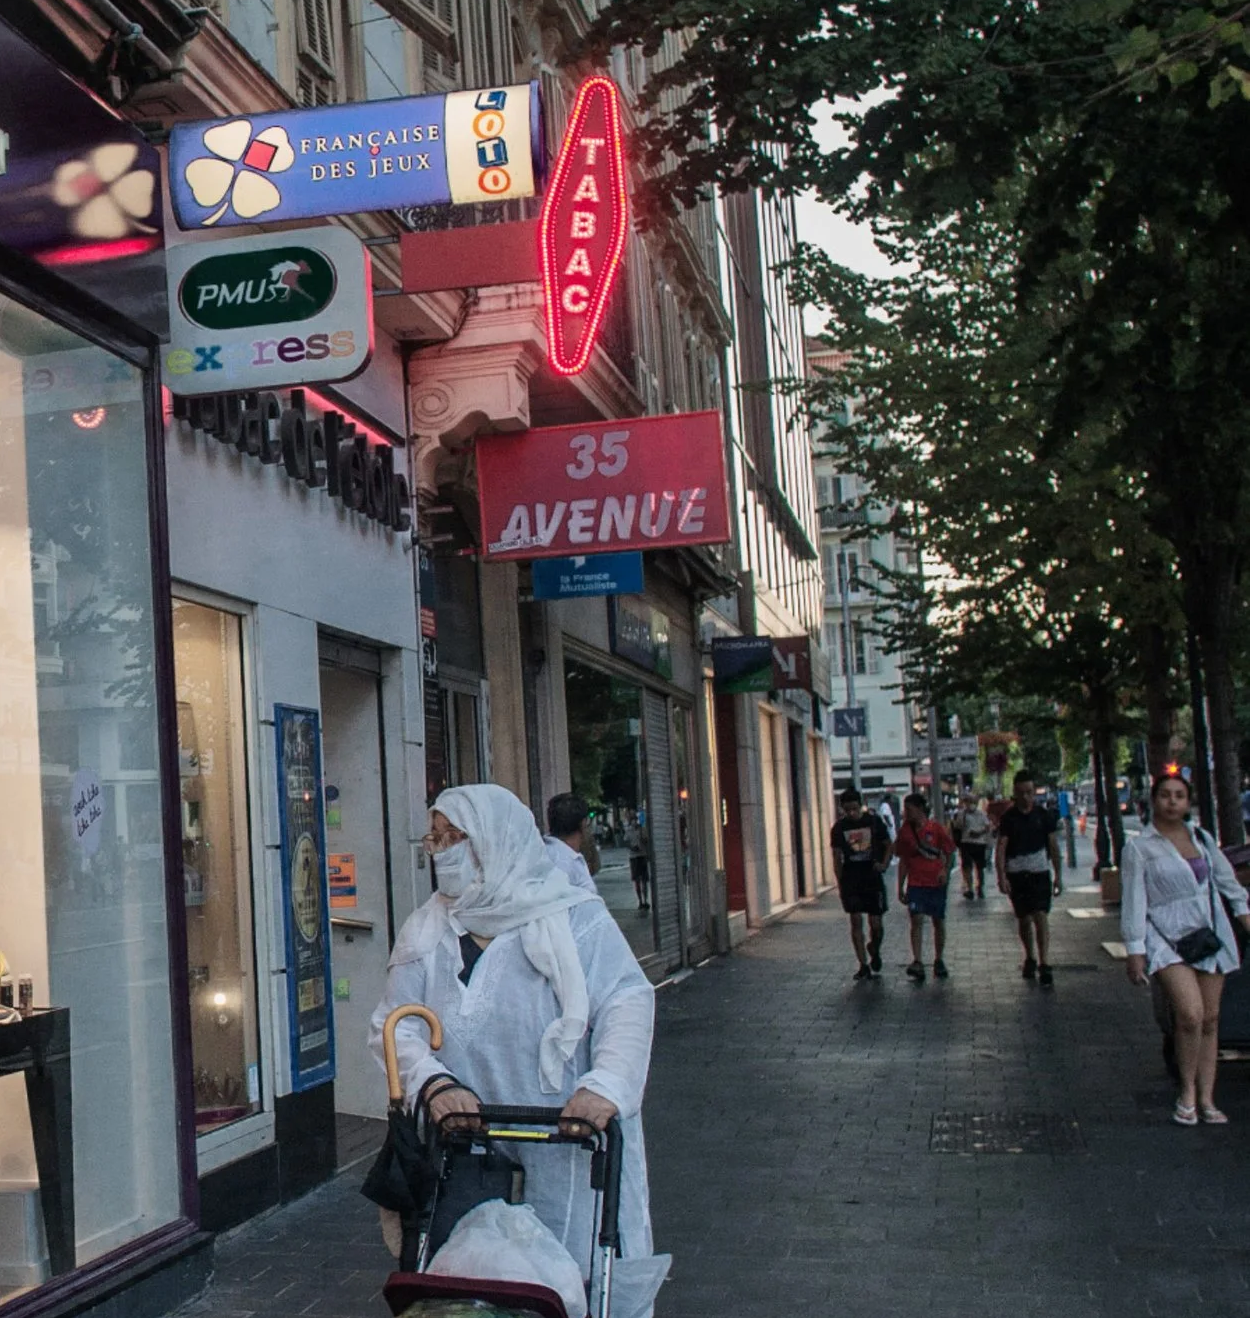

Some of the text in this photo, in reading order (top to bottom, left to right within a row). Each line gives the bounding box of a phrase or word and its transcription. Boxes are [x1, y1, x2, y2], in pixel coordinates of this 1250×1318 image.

[300, 124, 441, 155] FRANÇAISE
[473, 90, 512, 194] LOTO
[310, 153, 431, 181] DES JEUX
[562, 137, 606, 314] TABAC
[196, 279, 267, 309] PMU
[565, 430, 630, 480] 35
[500, 487, 708, 547] AVENUE
[573, 572, 610, 582] France
